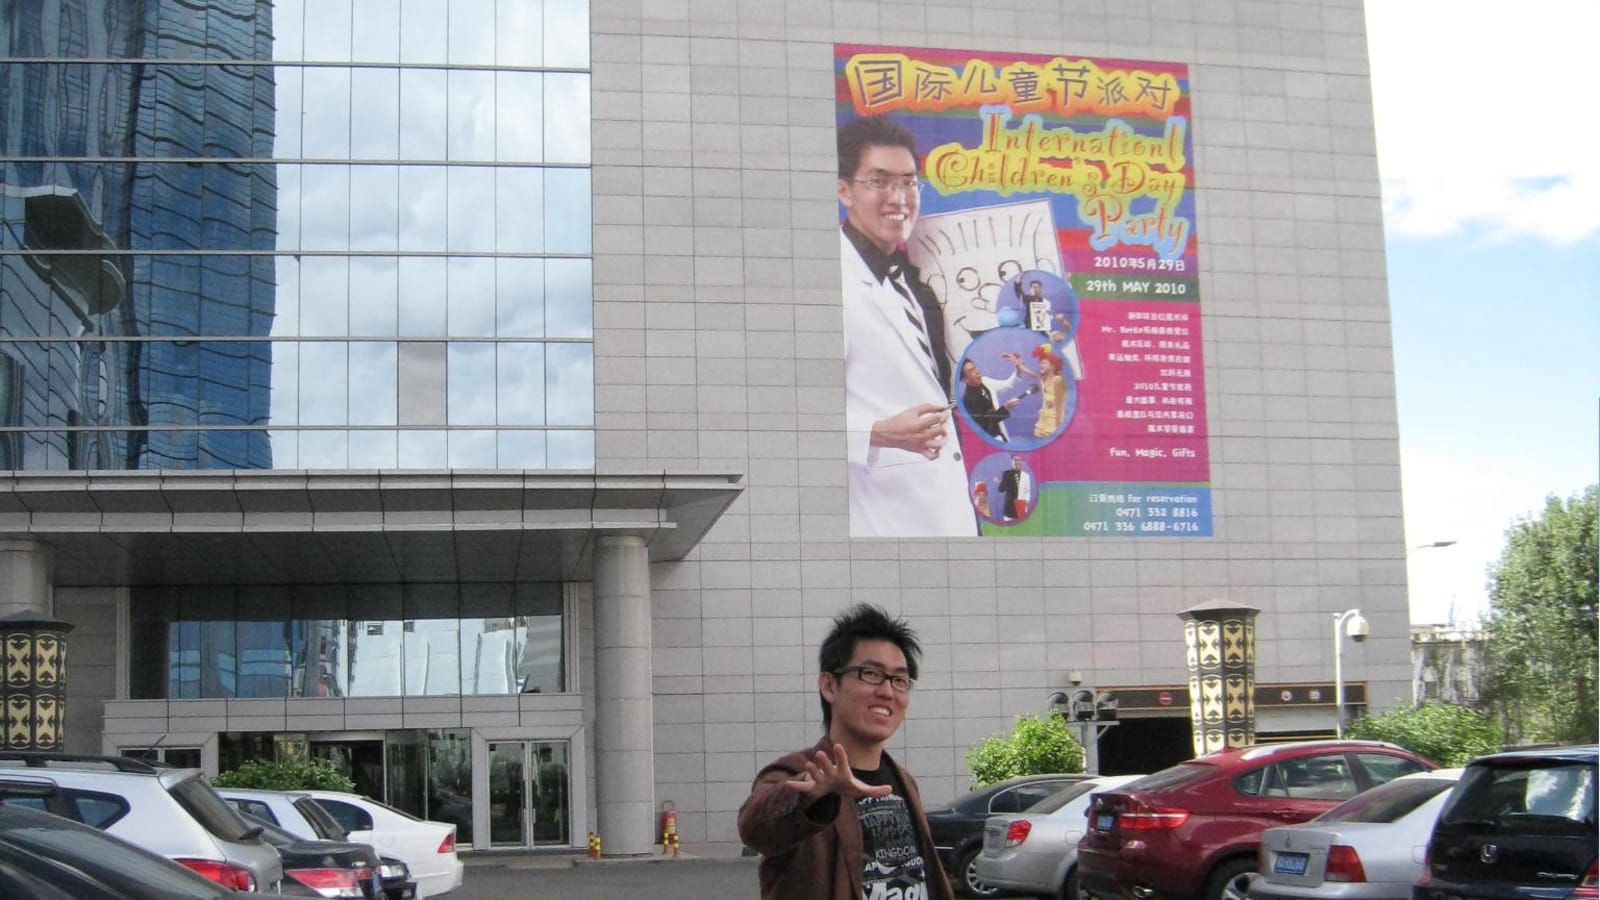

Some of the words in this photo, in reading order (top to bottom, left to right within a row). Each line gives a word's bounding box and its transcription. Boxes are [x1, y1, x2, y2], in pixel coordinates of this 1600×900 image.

[854, 59, 1172, 110] 国际儿童节派对
[1110, 160, 1178, 203] Day
[1082, 192, 1186, 255] Party
[1094, 256, 1185, 271] 2010年5月29日
[1086, 279, 1117, 292] 29th
[1122, 281, 1150, 293] MAY
[1155, 283, 1186, 294] 2010
[1171, 448, 1196, 457] Gifts
[1128, 494, 1142, 502] for
[1116, 508, 1141, 517] 0471
[1148, 508, 1167, 517] 332
[1172, 508, 1199, 518] 8816
[1083, 522, 1108, 531] 0471
[1115, 522, 1135, 531] 336
[1141, 522, 1199, 532] 6888-6716
